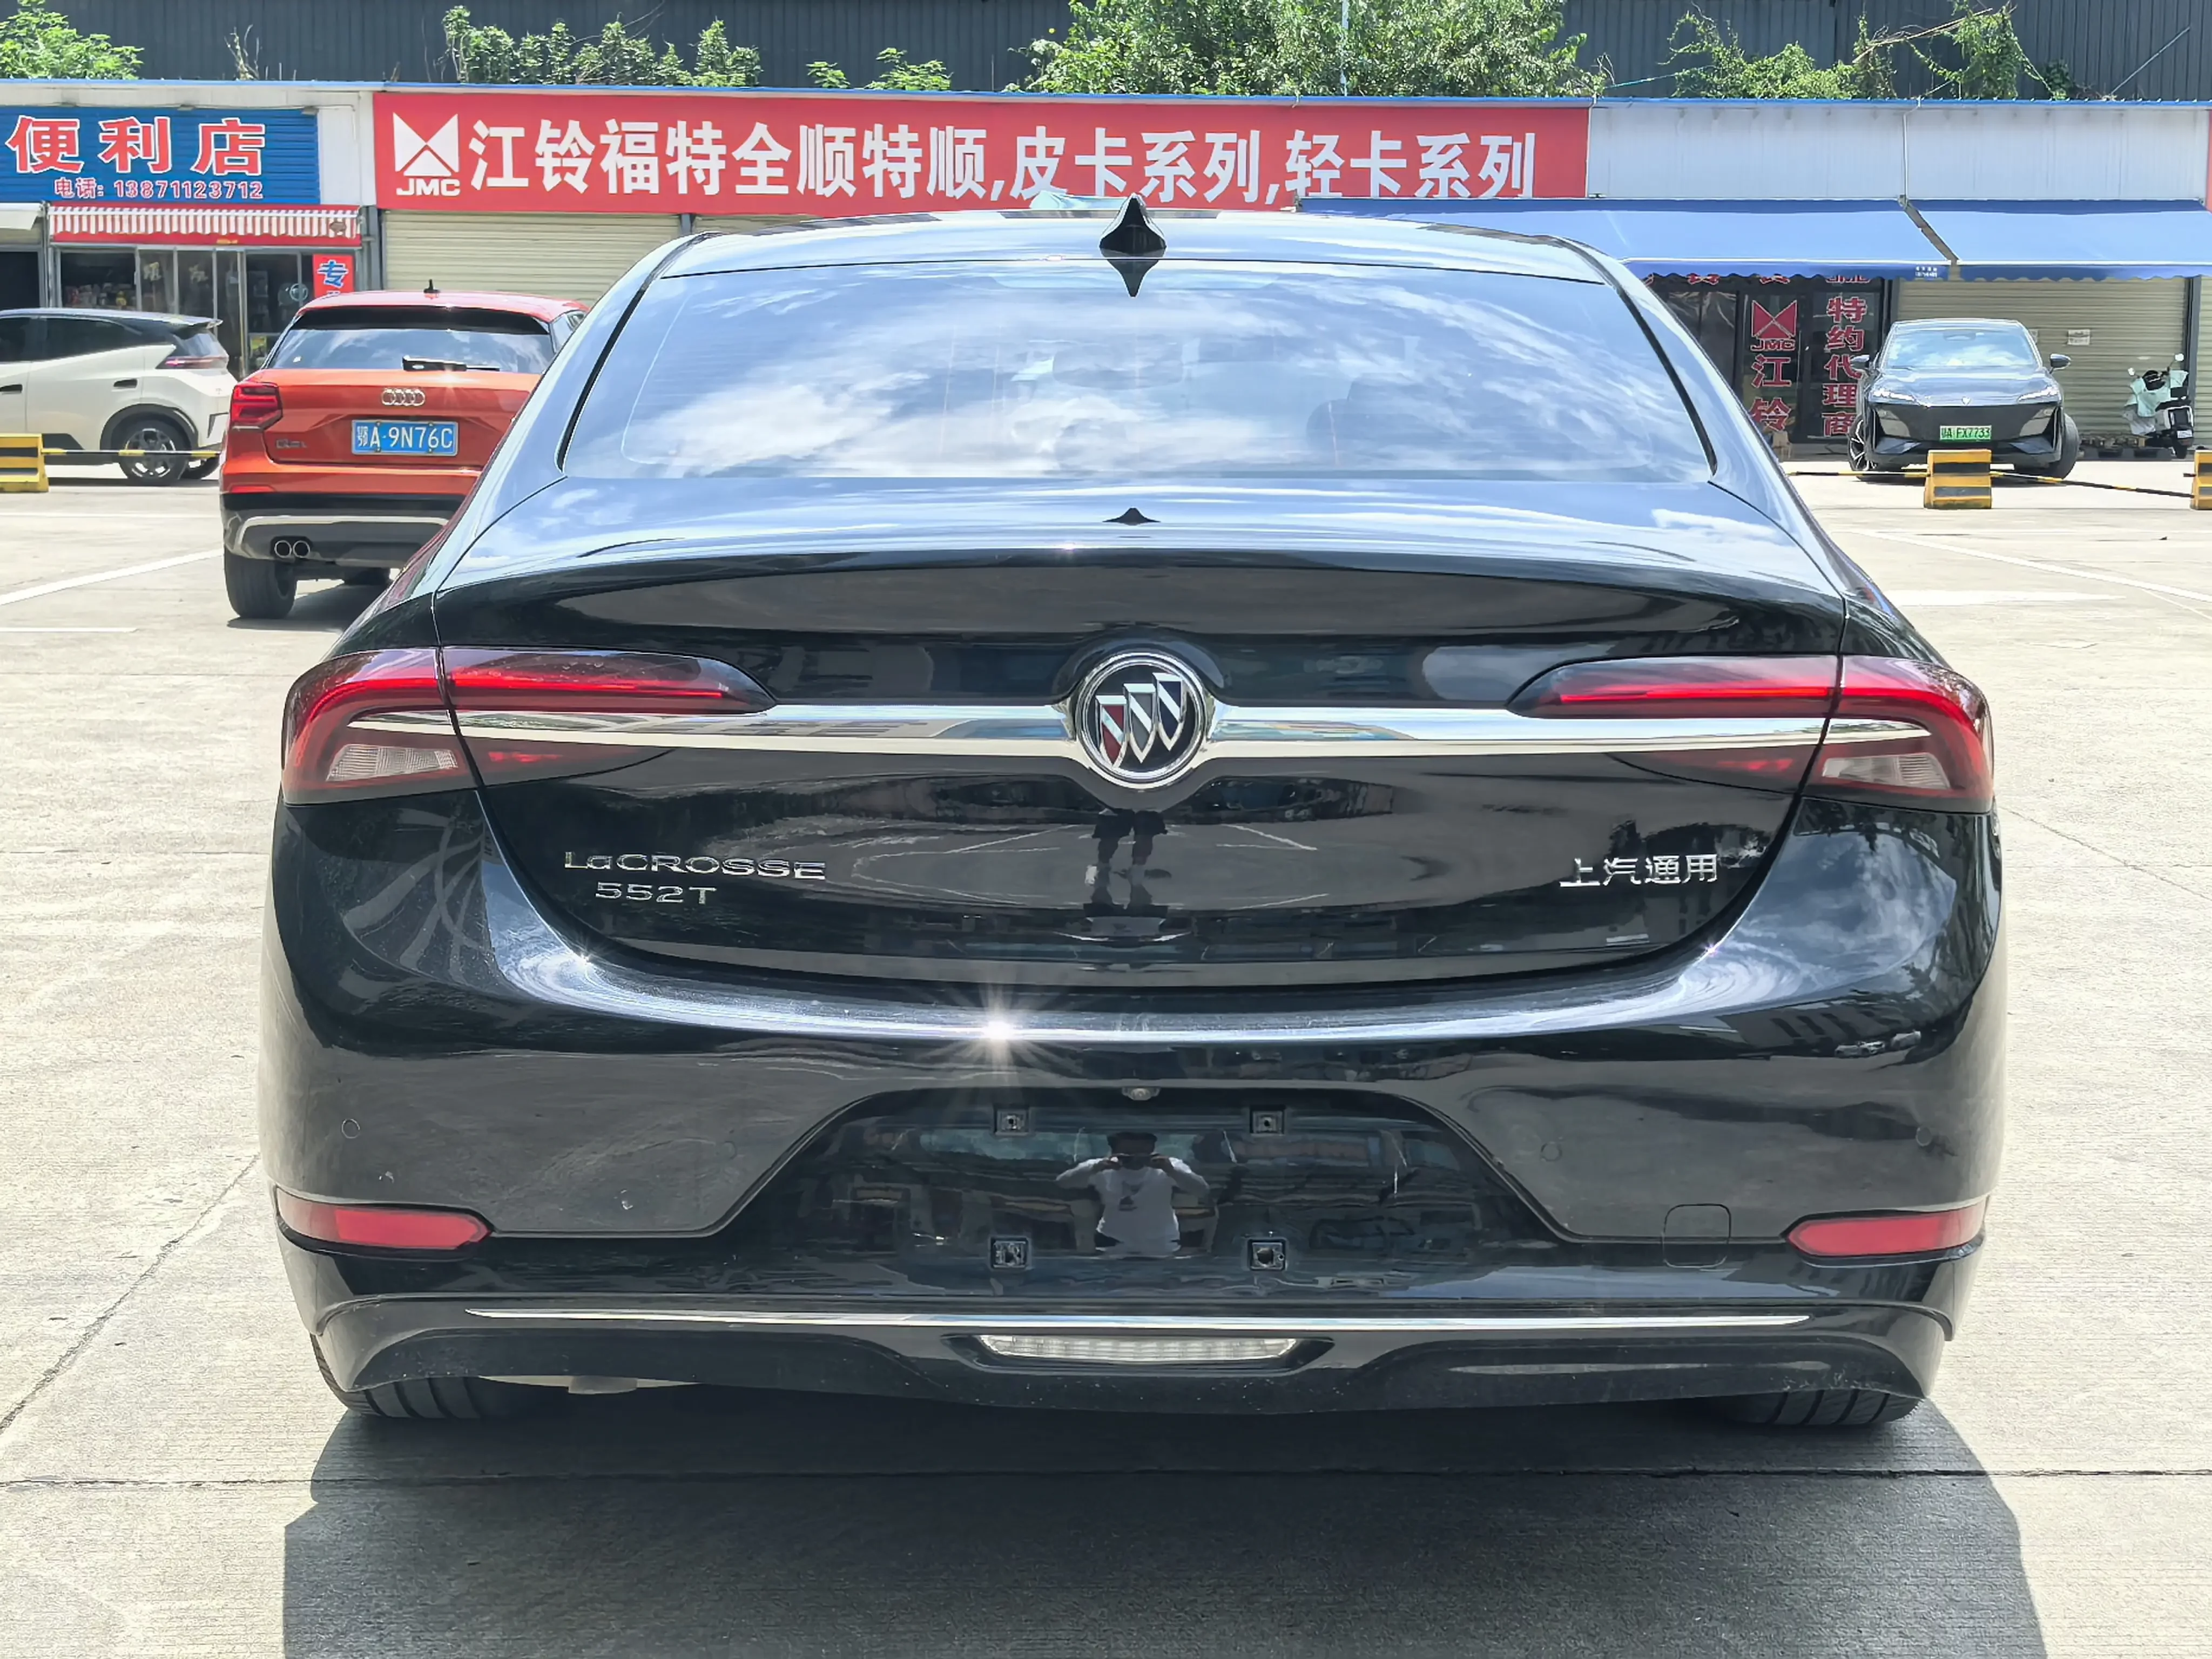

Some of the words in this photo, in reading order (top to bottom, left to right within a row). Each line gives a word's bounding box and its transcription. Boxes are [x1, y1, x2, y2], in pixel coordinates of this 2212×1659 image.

[6, 116, 265, 176] 便利店
[114, 180, 264, 199] 13871123712
[396, 177, 461, 197] JMC
[316, 259, 349, 296] 专
[1750, 339, 1796, 351] JMC
[1822, 296, 1867, 437] 特约代理商
[1749, 354, 1792, 431] 江铃
[1560, 854, 1717, 887] 上汽通用
[596, 881, 717, 905] 552T
